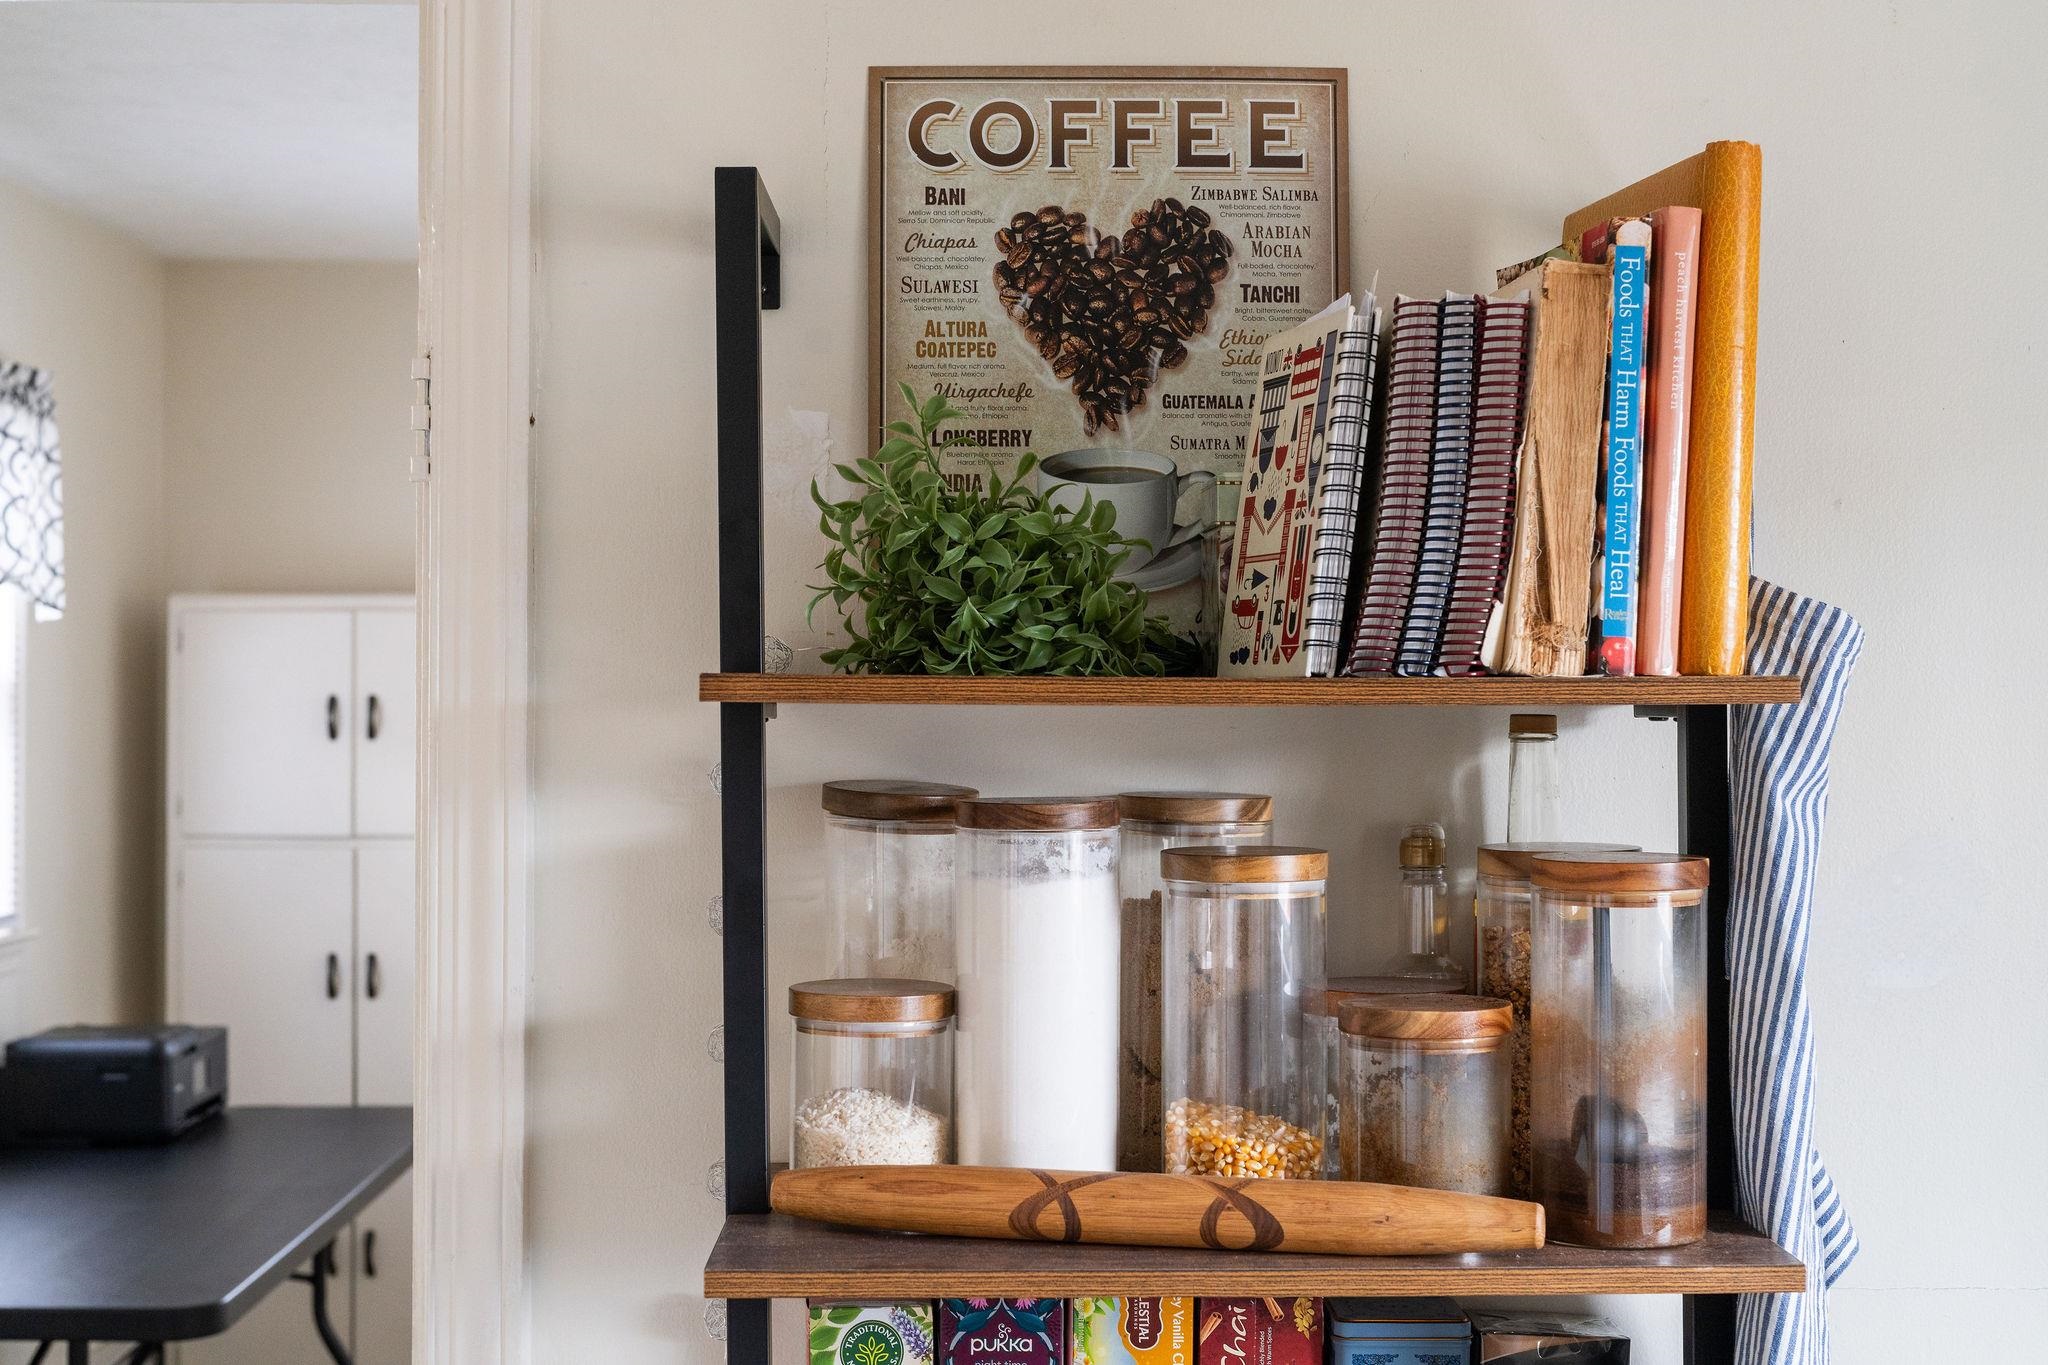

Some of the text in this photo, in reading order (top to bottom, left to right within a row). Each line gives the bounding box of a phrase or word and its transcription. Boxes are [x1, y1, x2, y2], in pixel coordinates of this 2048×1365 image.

[906, 97, 1308, 174] COFFEE
[925, 186, 966, 205] BANI
[1191, 186, 1318, 201] ZIMBABWE SALIMBA
[1243, 222, 1311, 239] ARABIAN
[905, 233, 978, 253] Chiapas
[1251, 241, 1302, 257] MOCHA
[901, 276, 978, 293] SULAWESI
[1240, 284, 1300, 303] TANCHI
[1619, 257, 1640, 317] Foods
[925, 320, 987, 337] ALTURA
[1670, 252, 1688, 409] peach harvest kitchen
[916, 340, 996, 358] COATEPEC
[1620, 323, 1633, 364] THAT
[1162, 394, 1243, 409] GUATEMALA
[1616, 370, 1637, 429] Harm
[931, 429, 1032, 447] LONGBERRY
[1171, 435, 1230, 450] SUMATRA
[1613, 437, 1634, 497] Foods
[940, 474, 983, 492] NDIA
[1614, 503, 1628, 544] THAT
[1609, 550, 1631, 598] Heal
[845, 1325, 898, 1348] TRADITIONAL
[1172, 1310, 1184, 1349] Vanilla
[970, 1332, 1033, 1355] pukka
